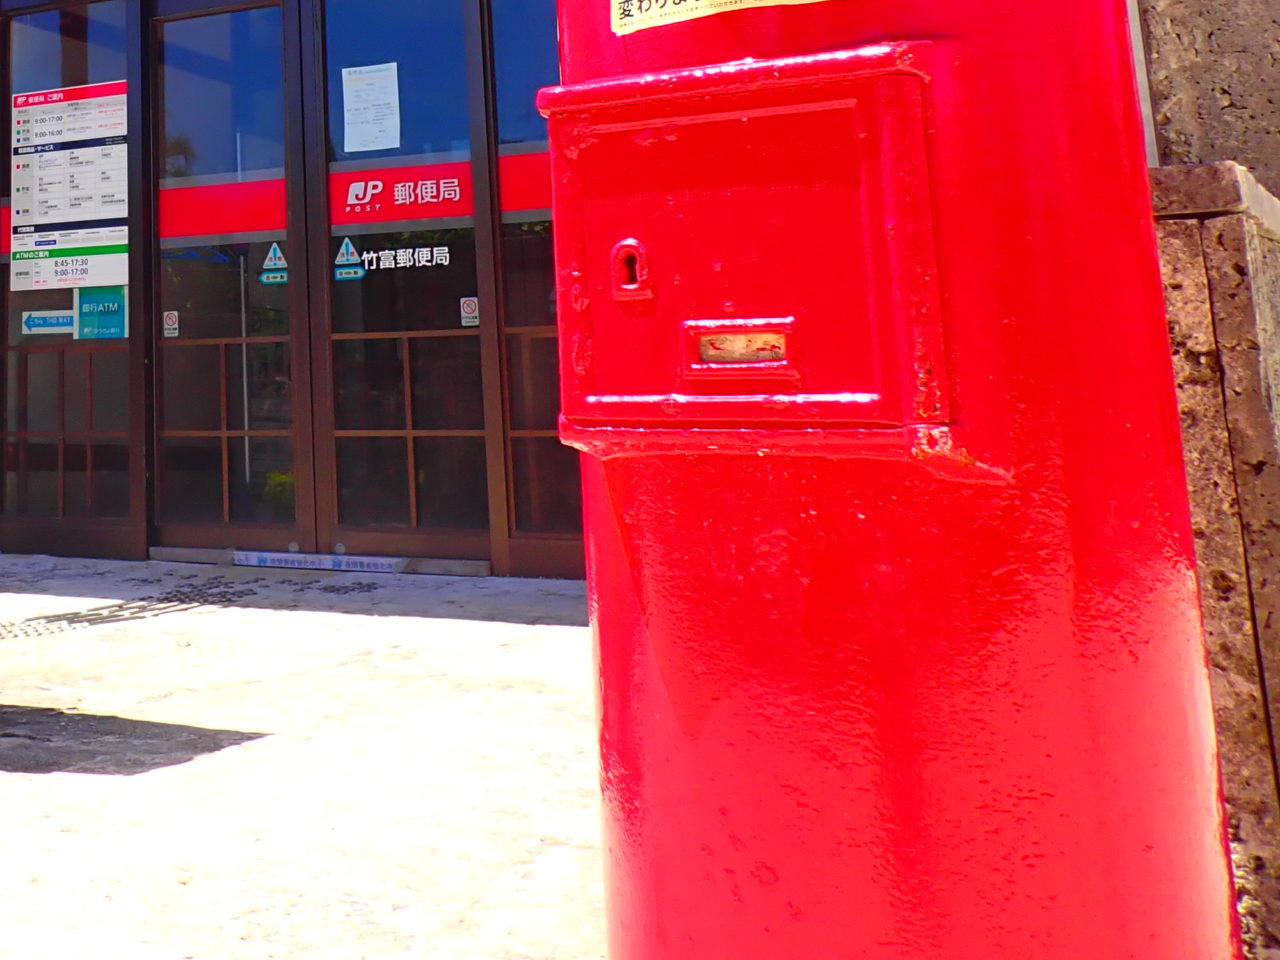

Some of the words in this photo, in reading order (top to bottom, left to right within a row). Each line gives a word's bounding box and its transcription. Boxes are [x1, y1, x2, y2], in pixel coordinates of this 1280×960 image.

[393, 178, 461, 205] 郵便局
[346, 203, 382, 213] POST
[54, 259, 89, 268] 8:45-17:30
[361, 246, 450, 272] 竹富郵便局
[54, 268, 89, 277] 9:00-17:00
[82, 303, 119, 312] 銀行ATM
